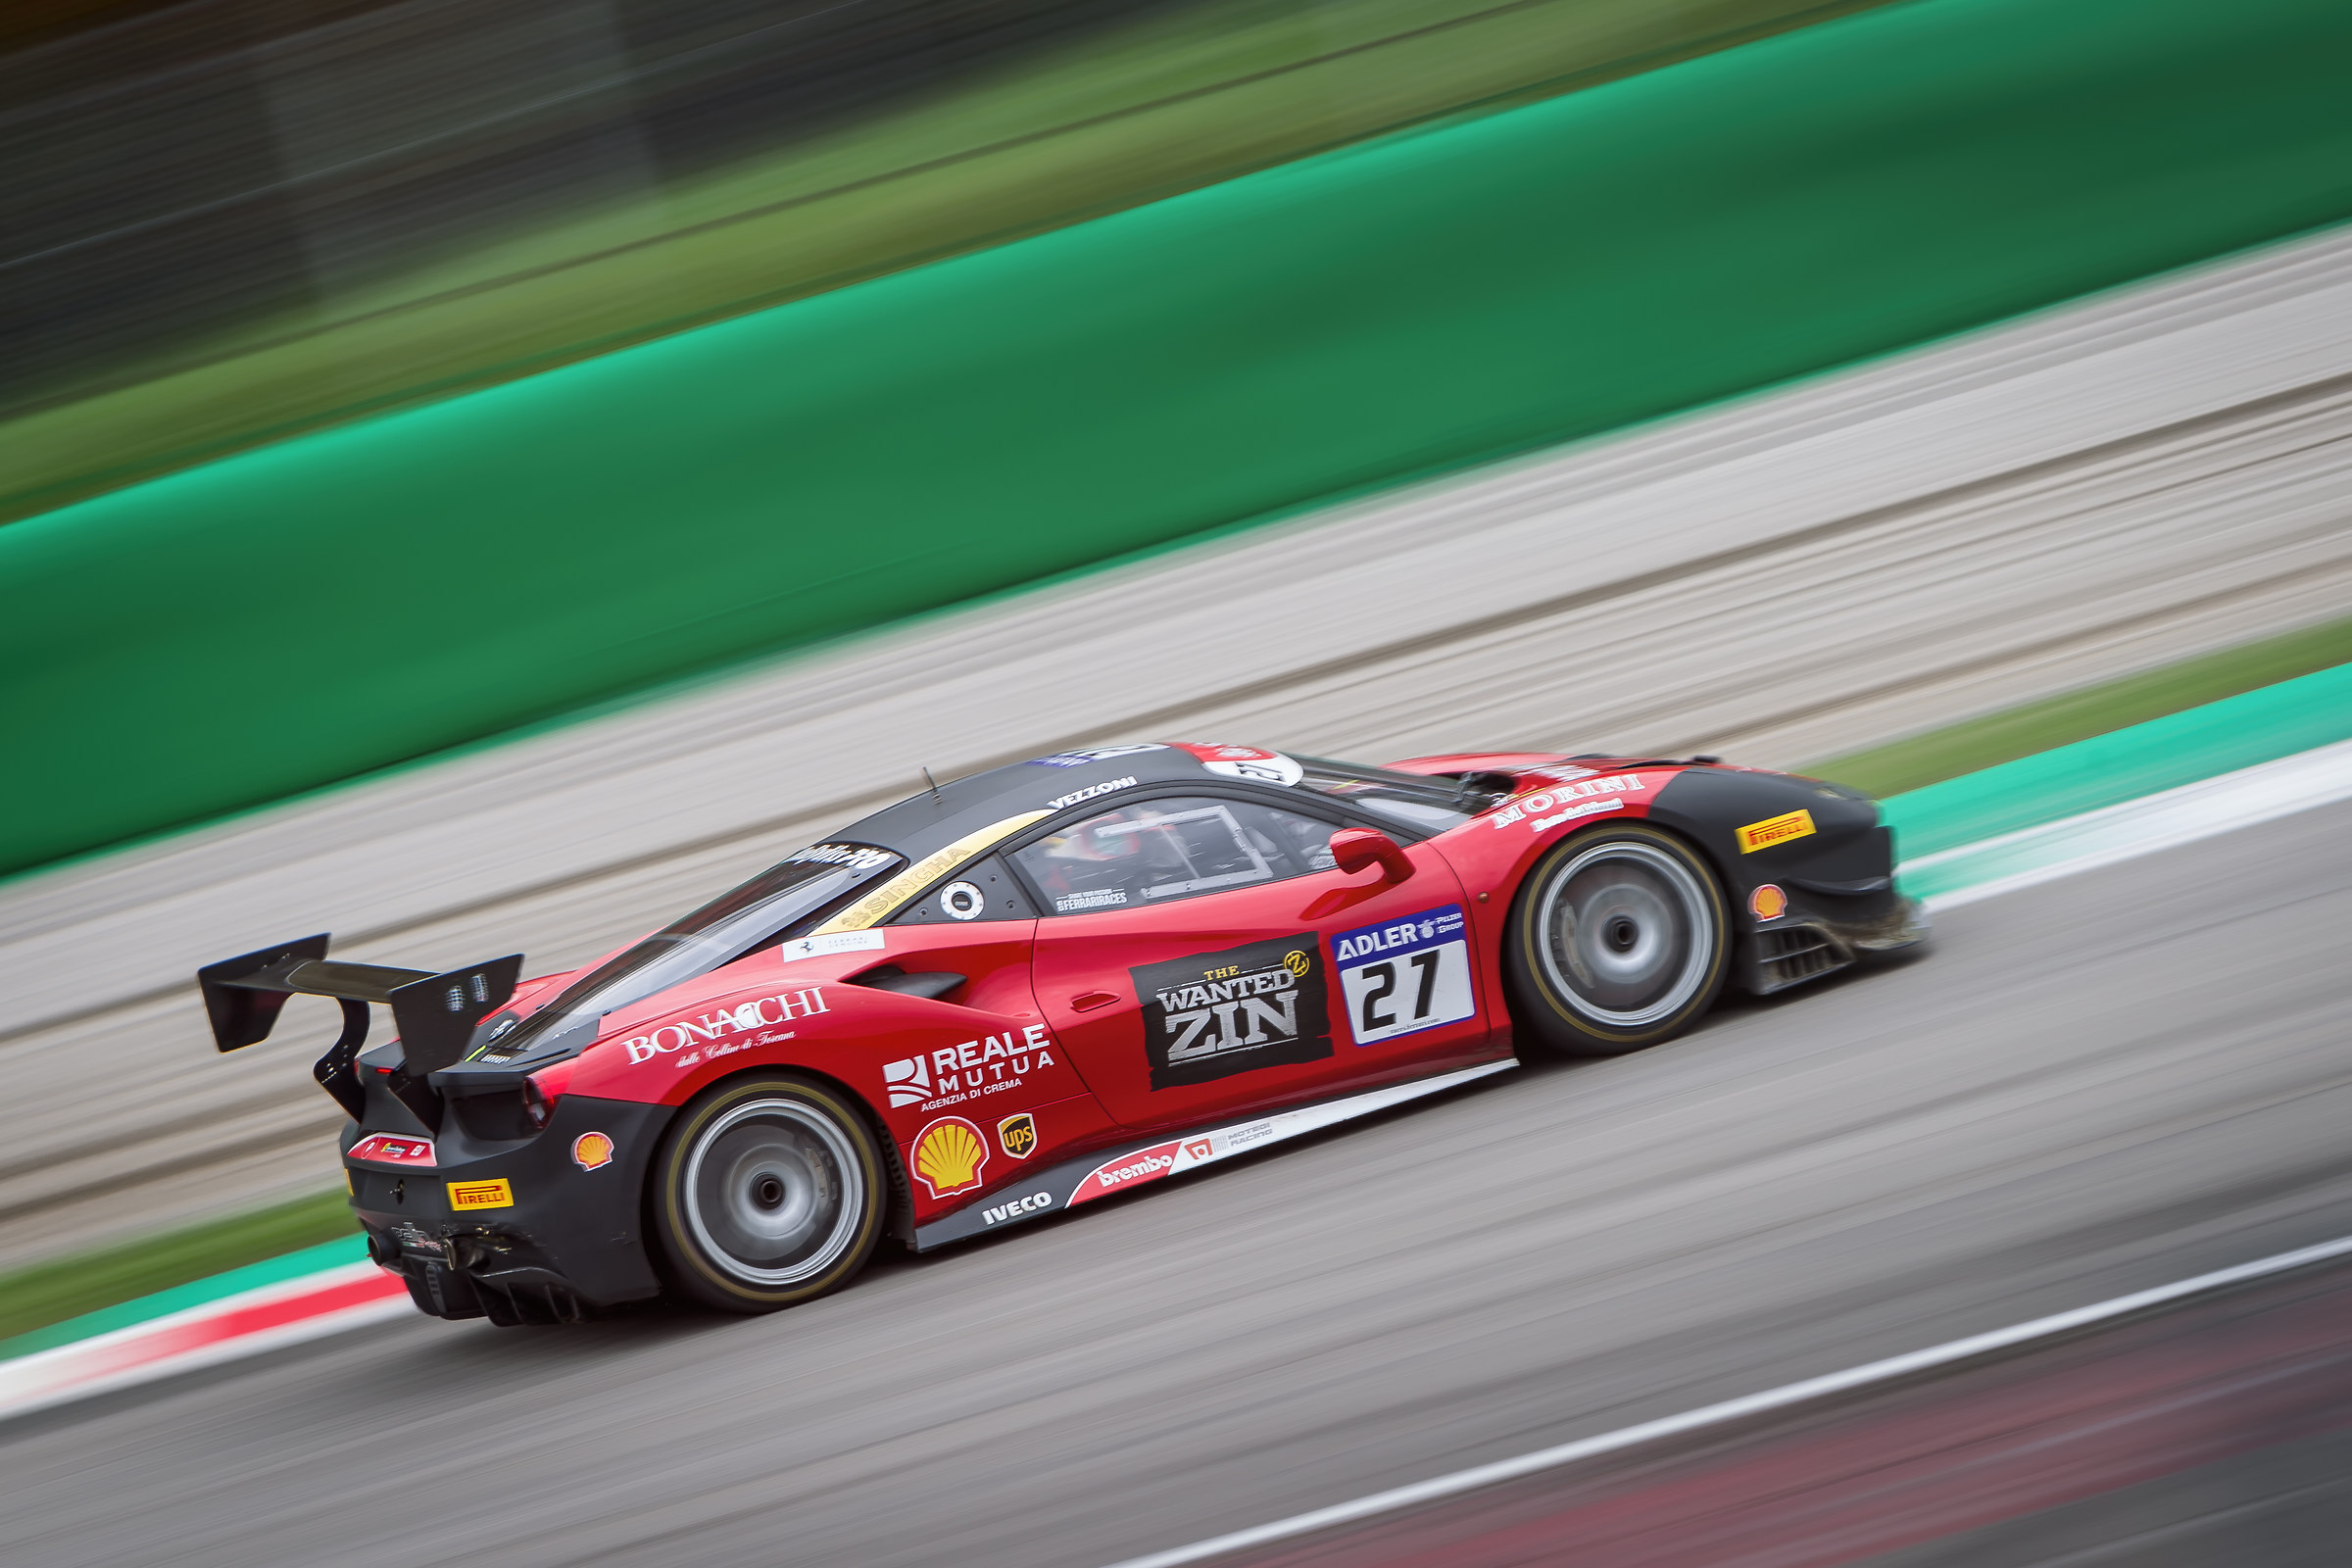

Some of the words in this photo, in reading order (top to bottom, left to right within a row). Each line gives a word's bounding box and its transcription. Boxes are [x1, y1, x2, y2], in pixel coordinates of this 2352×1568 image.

[1047, 775, 1138, 810] VEZZONI
[1492, 773, 1645, 830] MORINI
[1747, 815, 1808, 846] PIRELLI
[864, 848, 971, 915] SINGHA
[1337, 922, 1419, 961] ADLER
[1437, 921, 1464, 933] GROUP
[1155, 968, 1296, 1012] WANTED
[1203, 965, 1240, 981] THE
[1361, 949, 1441, 1032] 27
[619, 986, 831, 1065] BONACCHI
[1165, 989, 1299, 1062] ZIN
[932, 1022, 1051, 1076] REALE
[937, 1051, 1055, 1096] MUTUA
[920, 1093, 968, 1112] AGENZIA
[969, 1089, 981, 1100] DI
[983, 1078, 1022, 1096] CREMA
[1003, 1126, 1033, 1152] ups
[1228, 1122, 1270, 1140] MOTEGI
[1231, 1129, 1273, 1147] RACING
[1097, 1153, 1173, 1188] brembo
[454, 1185, 506, 1204] PIRELLI
[981, 1191, 1054, 1225] IVECO
